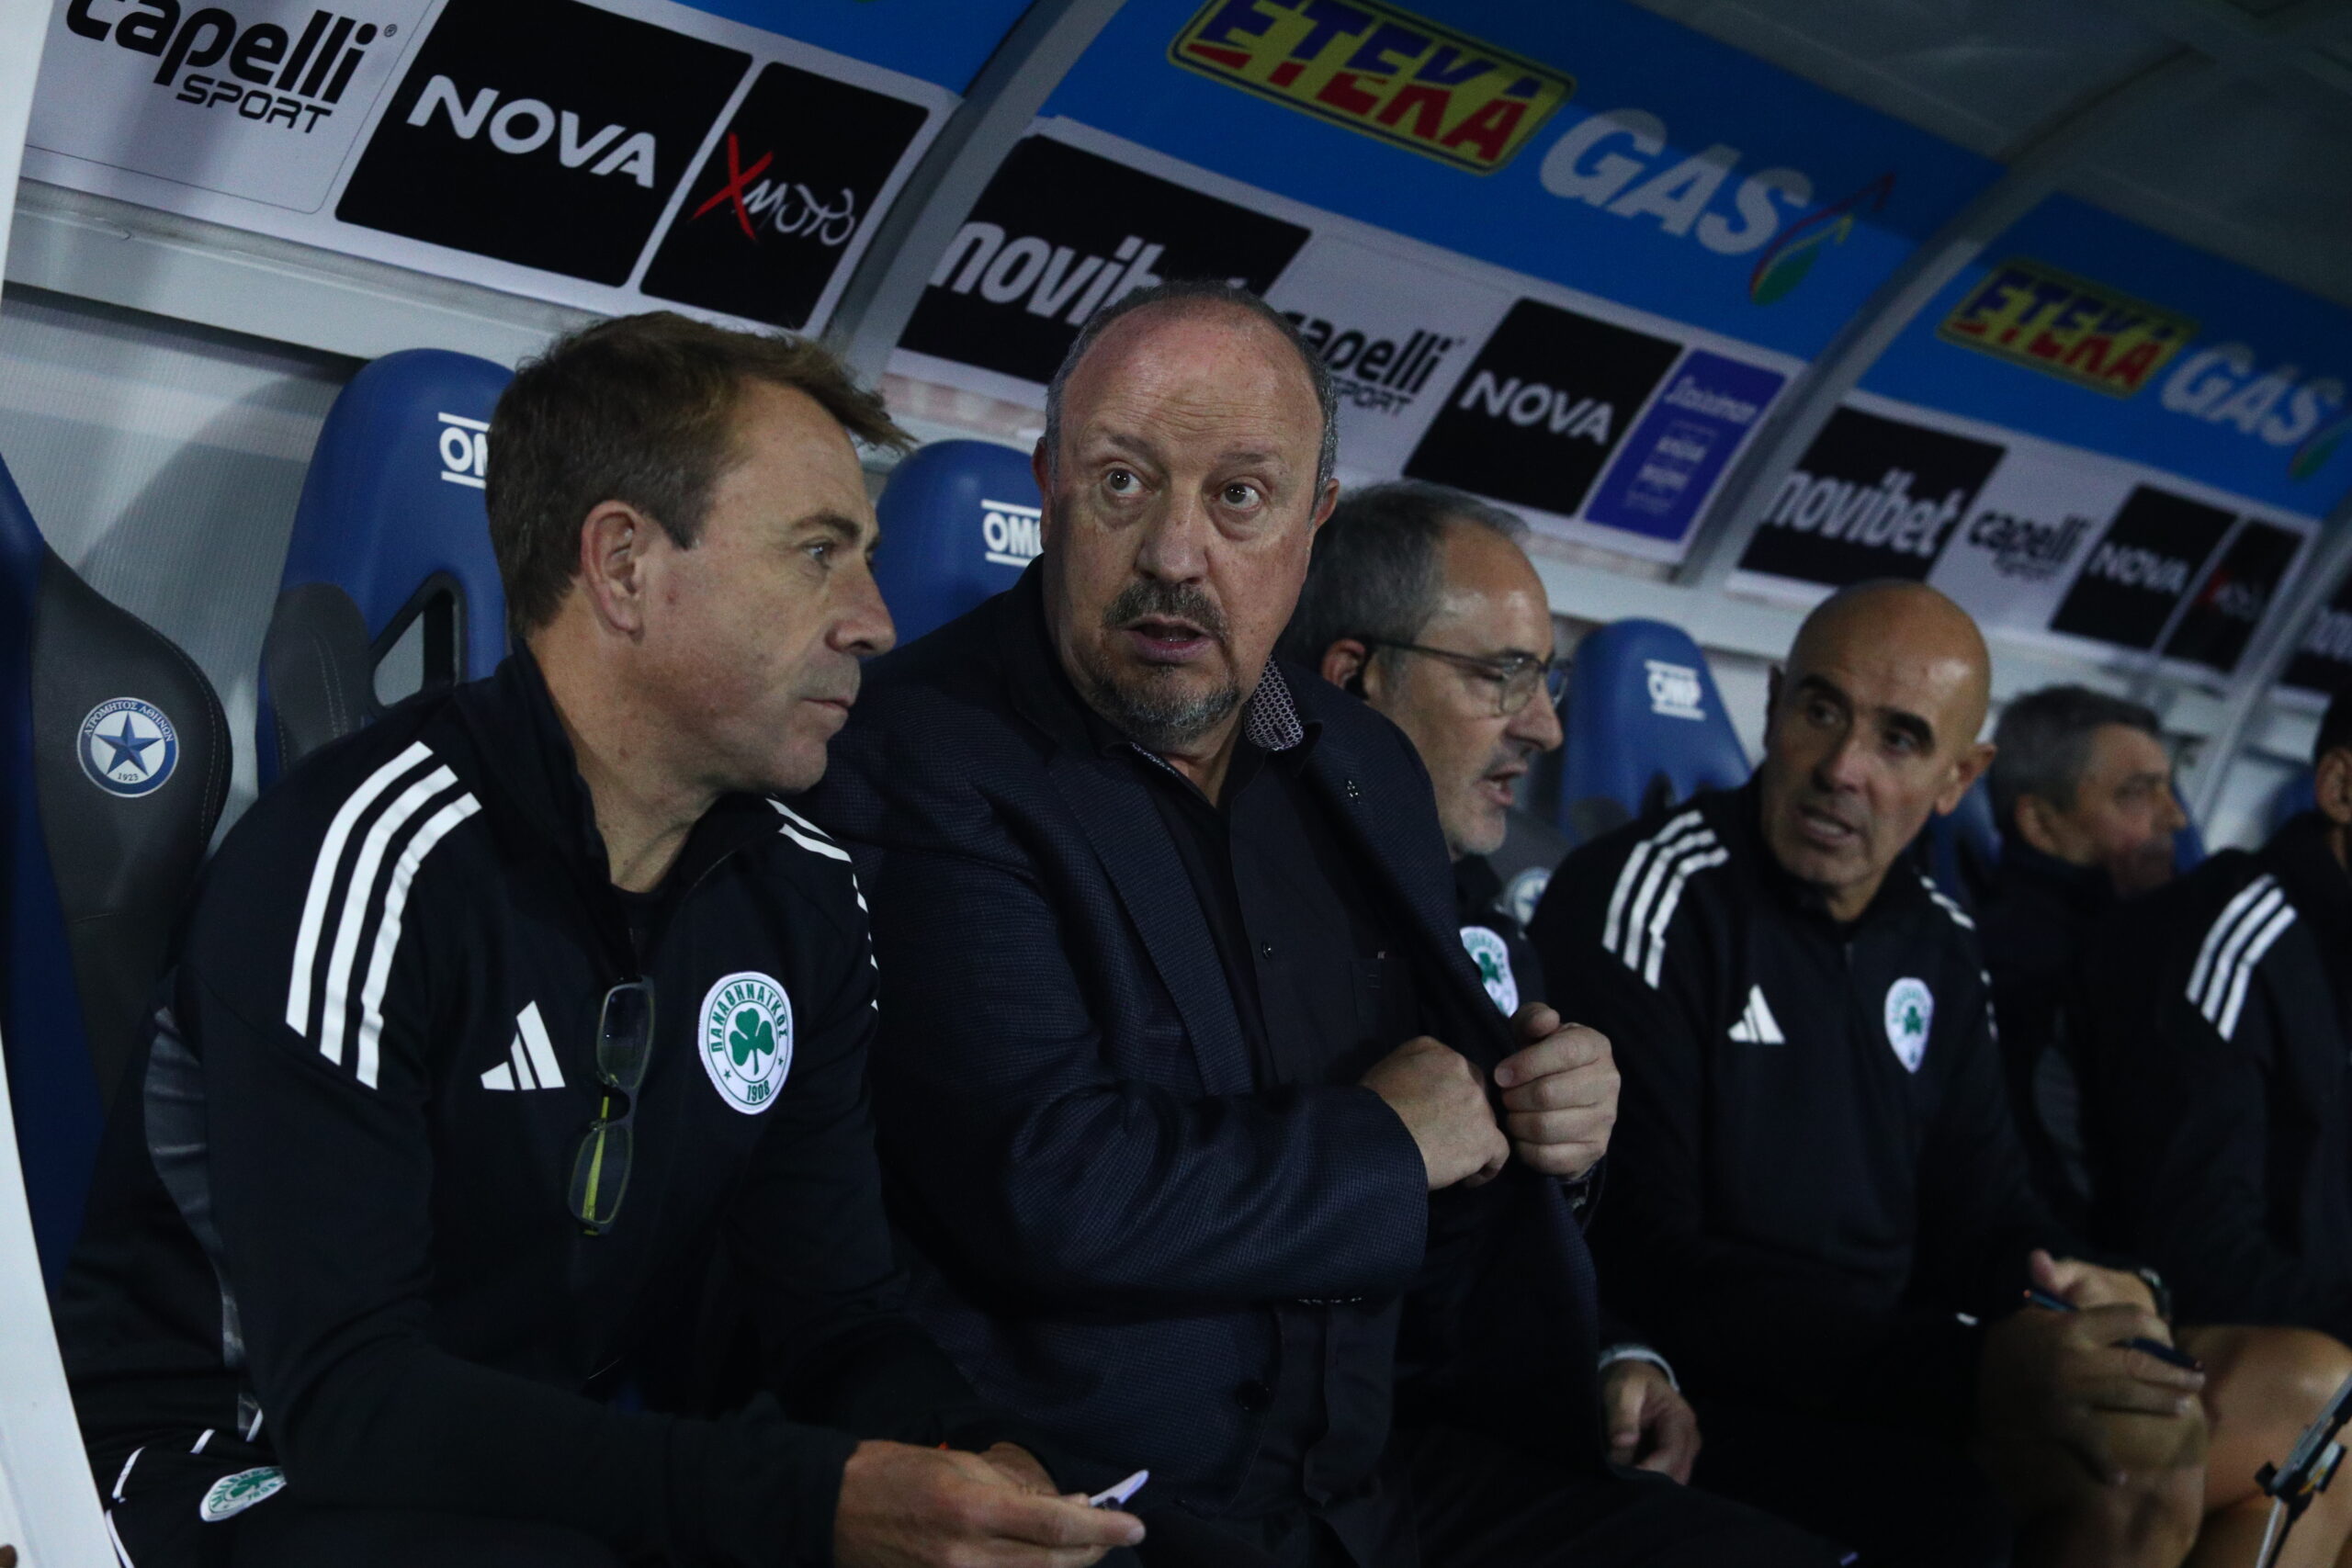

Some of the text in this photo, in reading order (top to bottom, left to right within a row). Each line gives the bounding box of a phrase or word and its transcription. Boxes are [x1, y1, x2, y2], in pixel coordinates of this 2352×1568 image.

[66, 0, 378, 105] capelli
[175, 73, 333, 134] SPORT
[406, 73, 656, 188] NOVA
[1187, 0, 1815, 256] ETEKA GAS
[928, 220, 1248, 328] novi
[1458, 370, 1615, 446] NOVA
[2159, 342, 2346, 446] GAS
[1765, 467, 1964, 558] novibet
[117, 771, 139, 782] 1923
[746, 1079, 771, 1102] 1908
